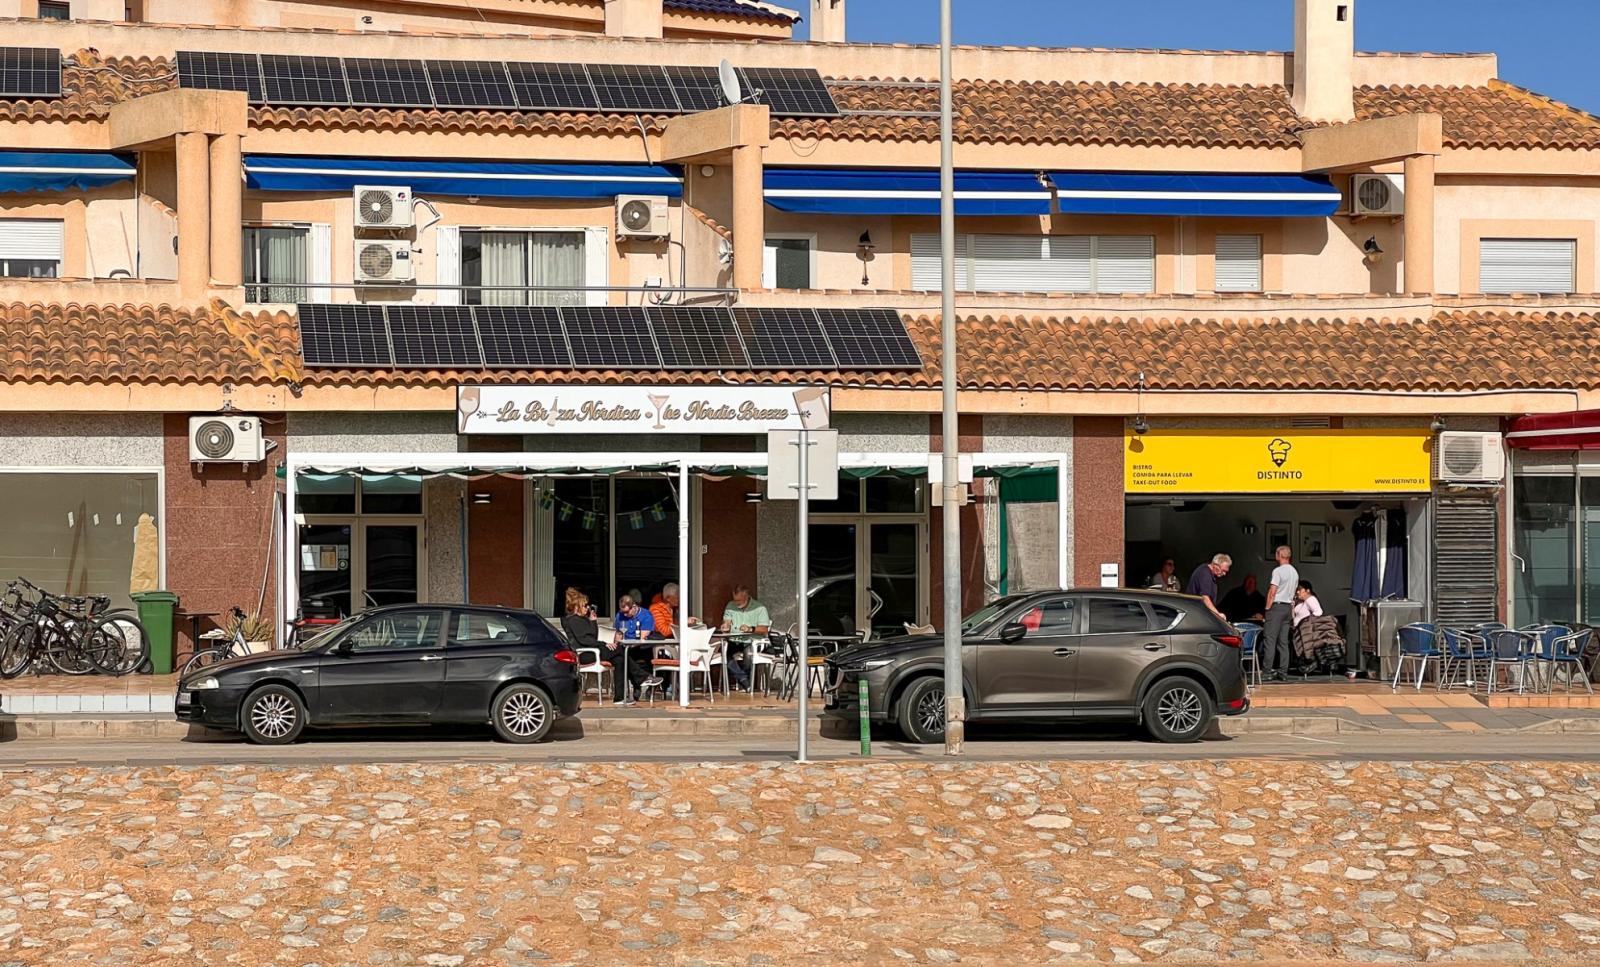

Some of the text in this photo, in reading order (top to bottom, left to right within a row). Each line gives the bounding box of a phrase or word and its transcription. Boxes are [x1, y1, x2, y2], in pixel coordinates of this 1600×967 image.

[496, 400, 521, 422] La
[575, 399, 642, 422] Nordica
[683, 400, 736, 421] Nordic
[737, 399, 789, 422] Breeze
[1257, 470, 1303, 480] DISTINTO
